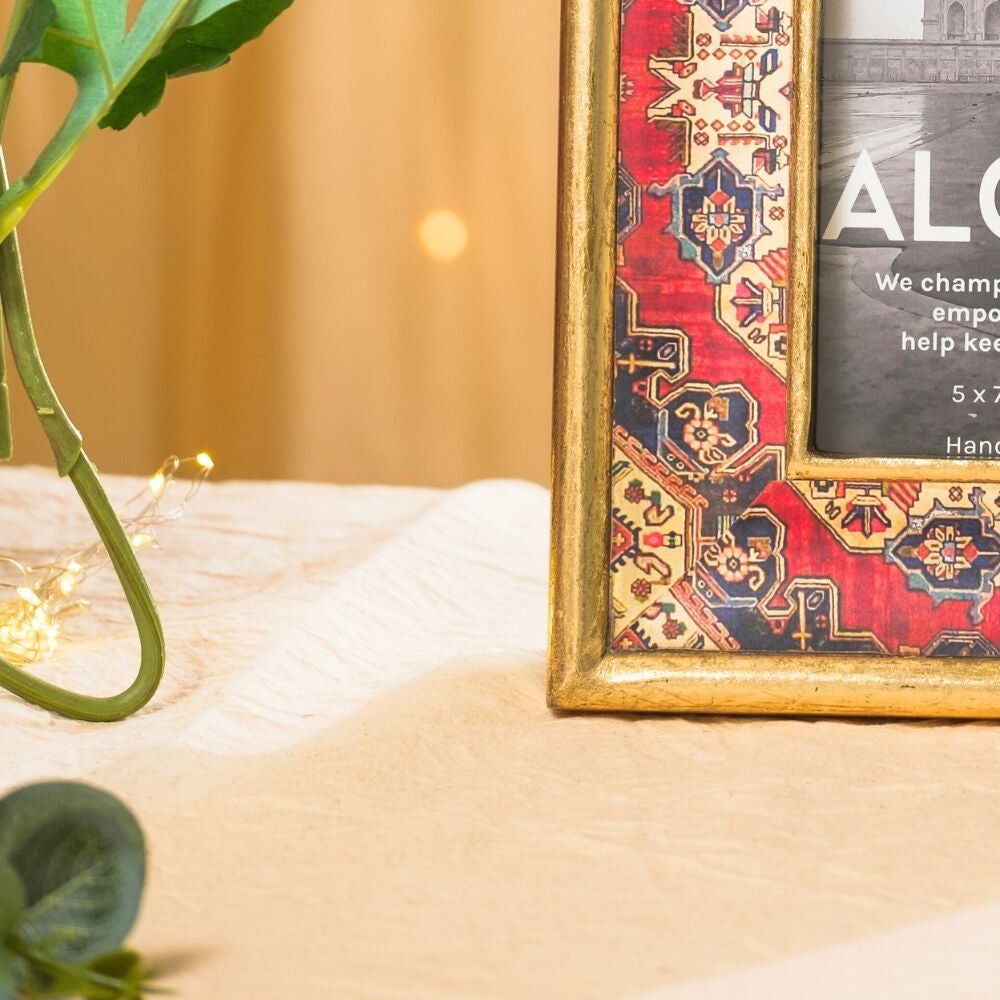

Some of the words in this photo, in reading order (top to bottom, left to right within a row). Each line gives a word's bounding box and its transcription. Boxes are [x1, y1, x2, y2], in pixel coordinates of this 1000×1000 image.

[875, 271, 913, 292] We
[901, 331, 955, 356] help
[952, 384, 965, 403] 5
[973, 389, 986, 403] x
